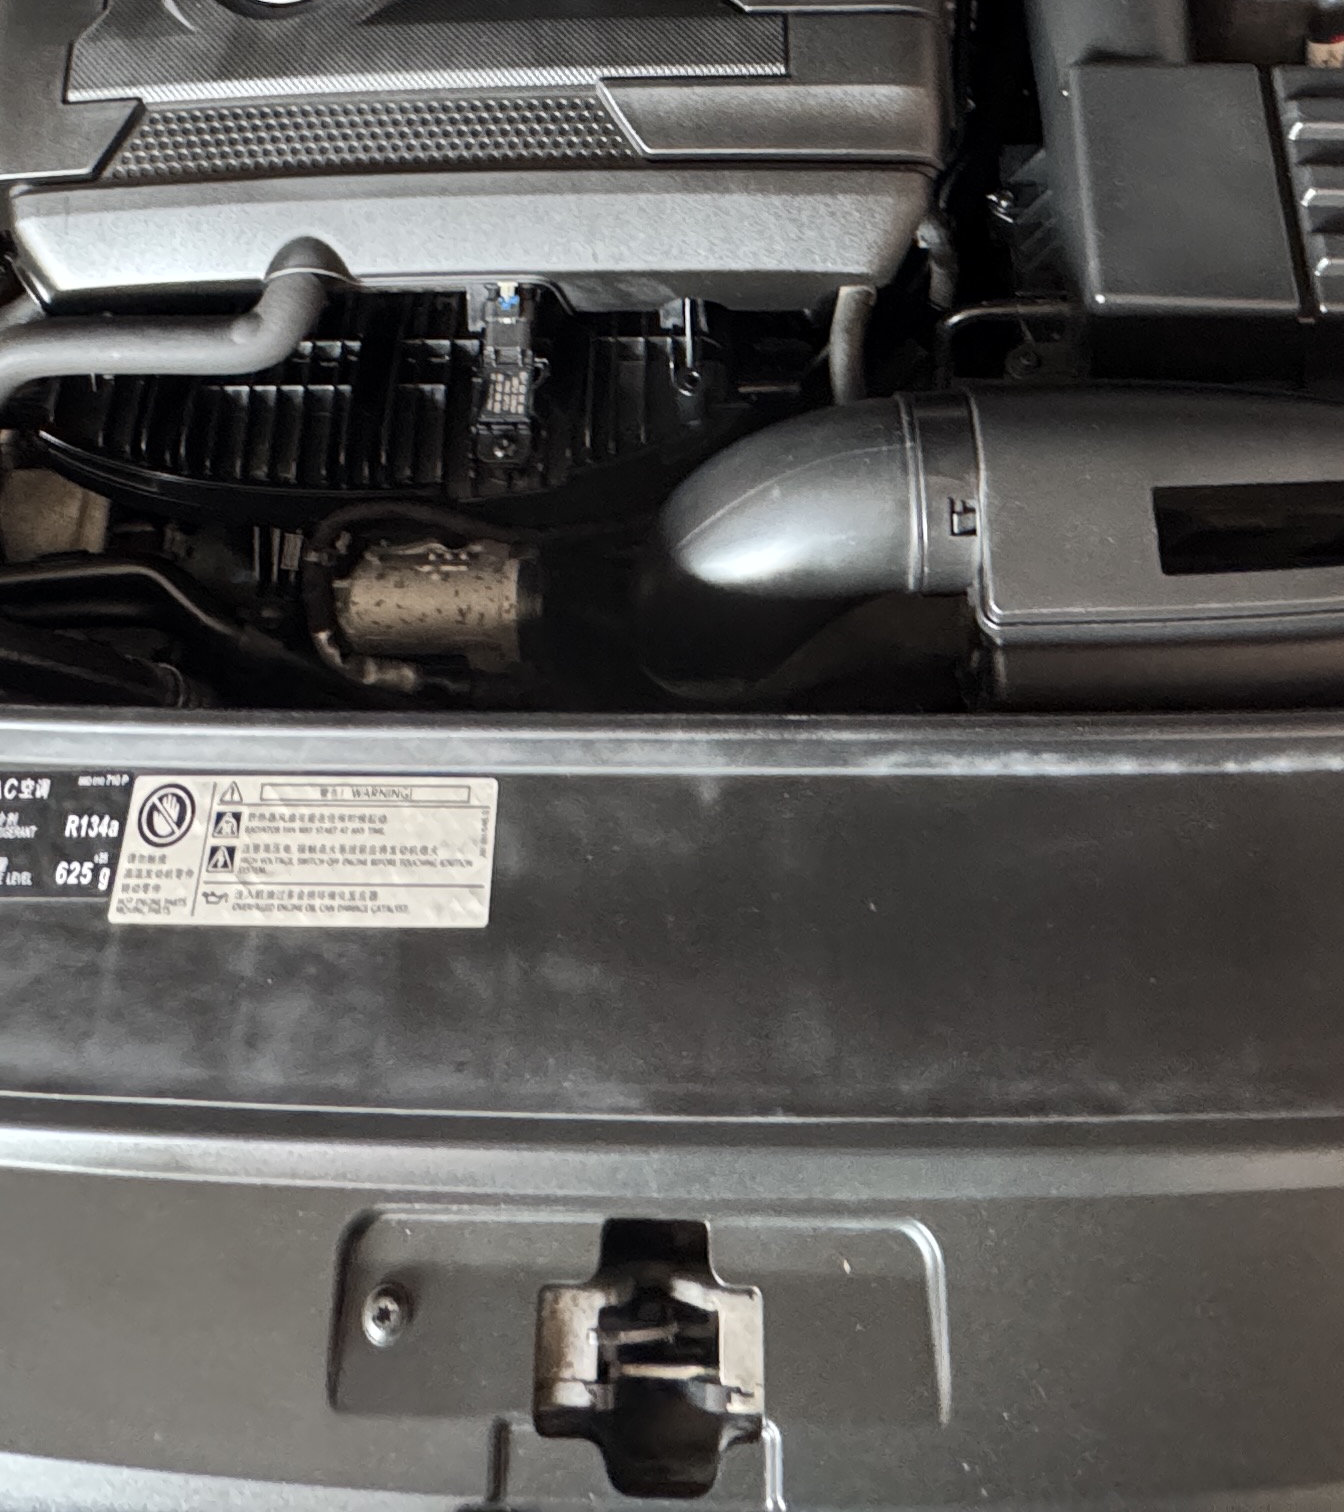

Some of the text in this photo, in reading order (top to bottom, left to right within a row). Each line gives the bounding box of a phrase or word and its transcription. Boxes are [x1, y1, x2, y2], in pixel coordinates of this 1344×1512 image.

[64, 814, 120, 838] R134a
[56, 861, 94, 885] 625
[97, 867, 111, 890] g
